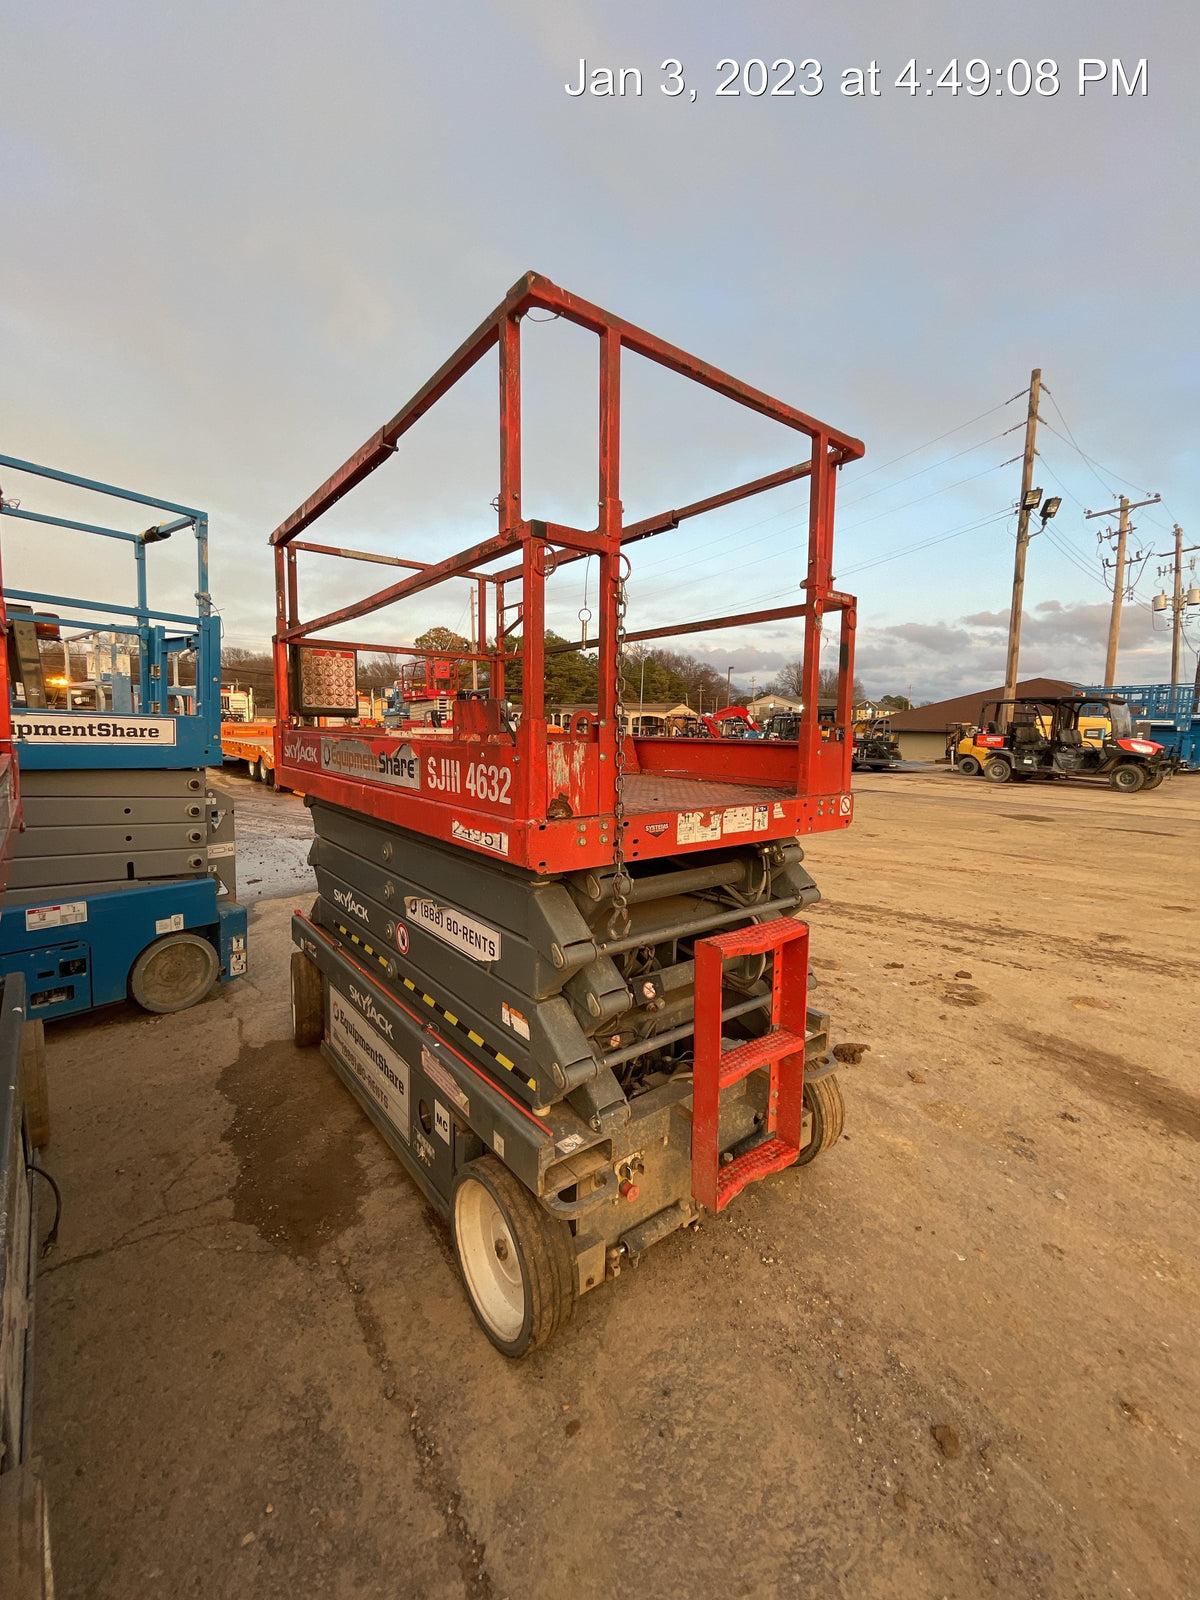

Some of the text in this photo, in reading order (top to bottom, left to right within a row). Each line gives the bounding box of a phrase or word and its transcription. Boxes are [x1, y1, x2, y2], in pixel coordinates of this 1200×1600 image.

[284, 738, 318, 763] SKYJACK
[331, 747, 415, 779] EquipmentShare
[465, 762, 512, 805] 4632
[333, 888, 371, 924] SKYJACK
[420, 901, 496, 958] (888) 80-RENTS
[349, 984, 395, 1041] SKYJACK
[339, 1007, 405, 1096] EquipmentShare
[435, 1111, 449, 1133] MC
